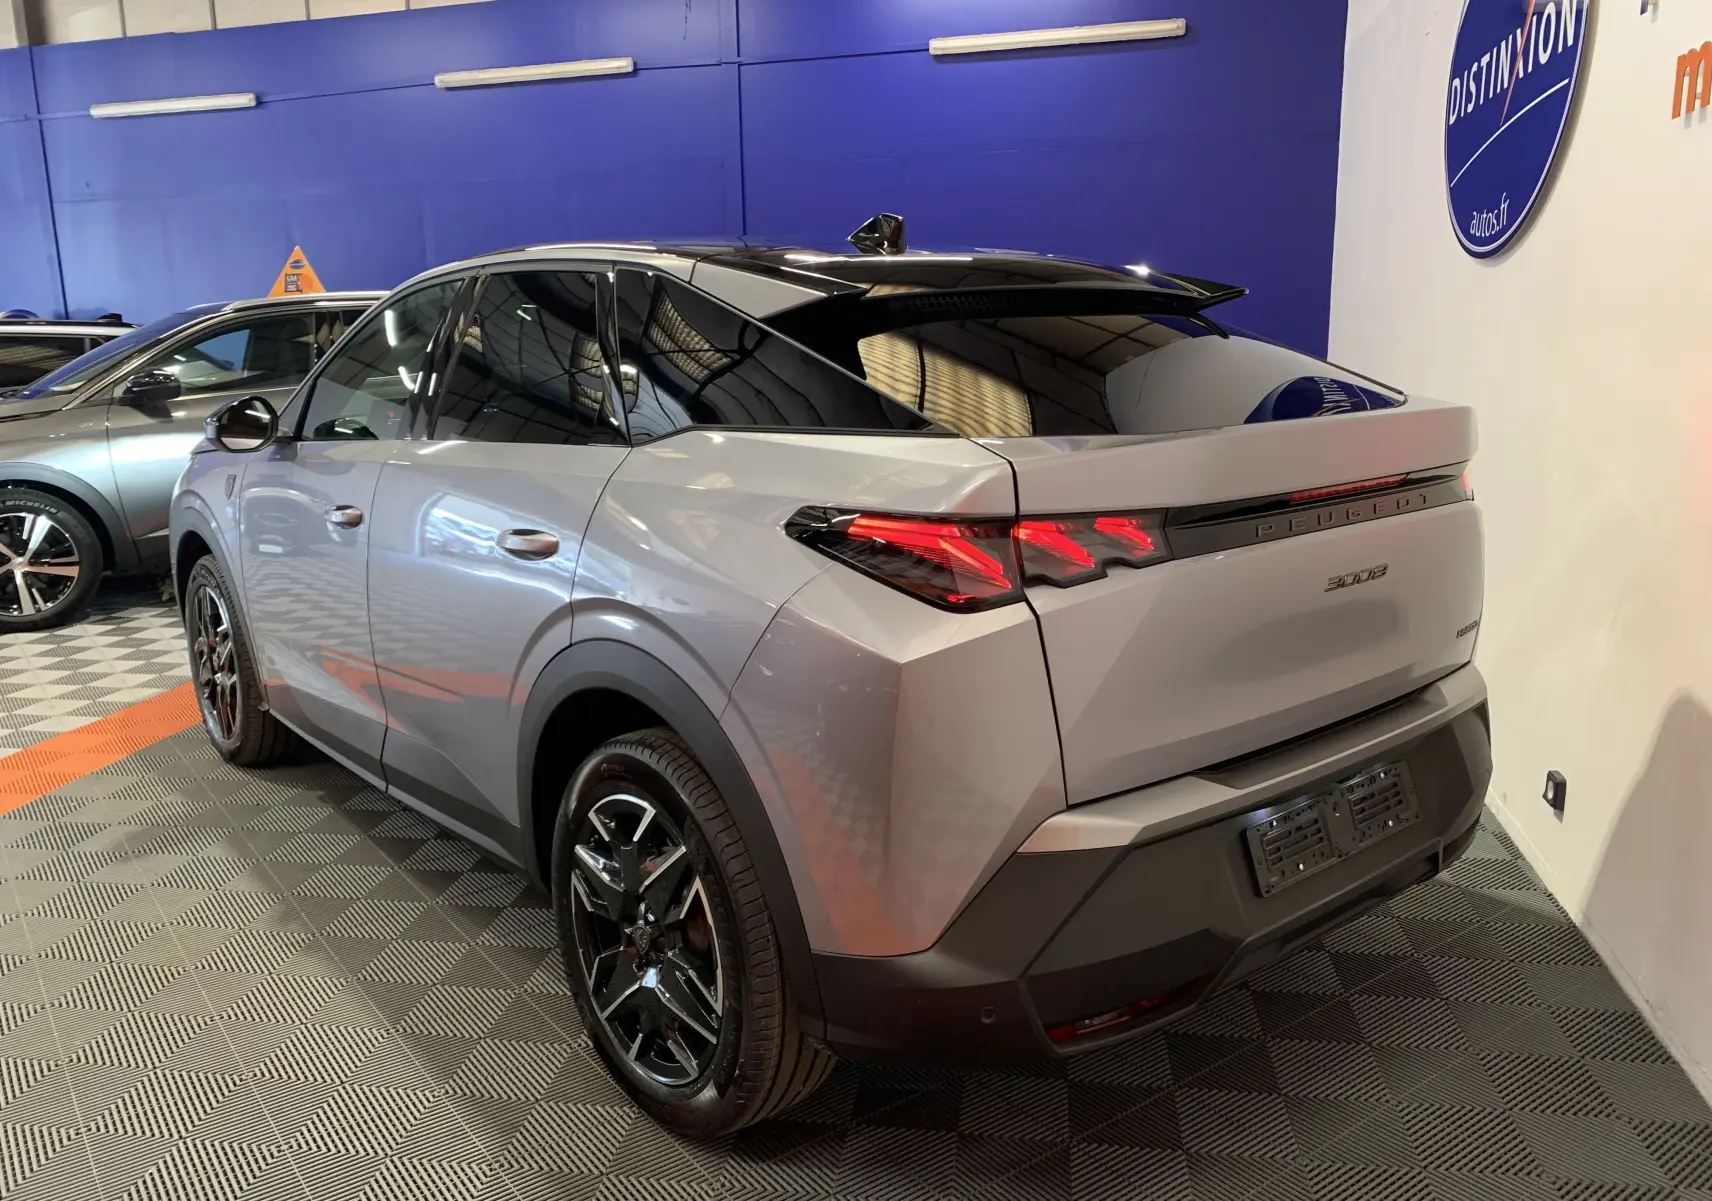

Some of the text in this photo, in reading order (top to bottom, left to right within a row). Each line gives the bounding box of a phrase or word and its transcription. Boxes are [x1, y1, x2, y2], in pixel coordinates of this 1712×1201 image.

[1449, 0, 1577, 126] DISTINXION
[1470, 192, 1510, 238] autos.fr
[5, 500, 58, 514] MICHELIN
[1255, 493, 1434, 538] PEUGEOT
[1324, 563, 1389, 593] 3008
